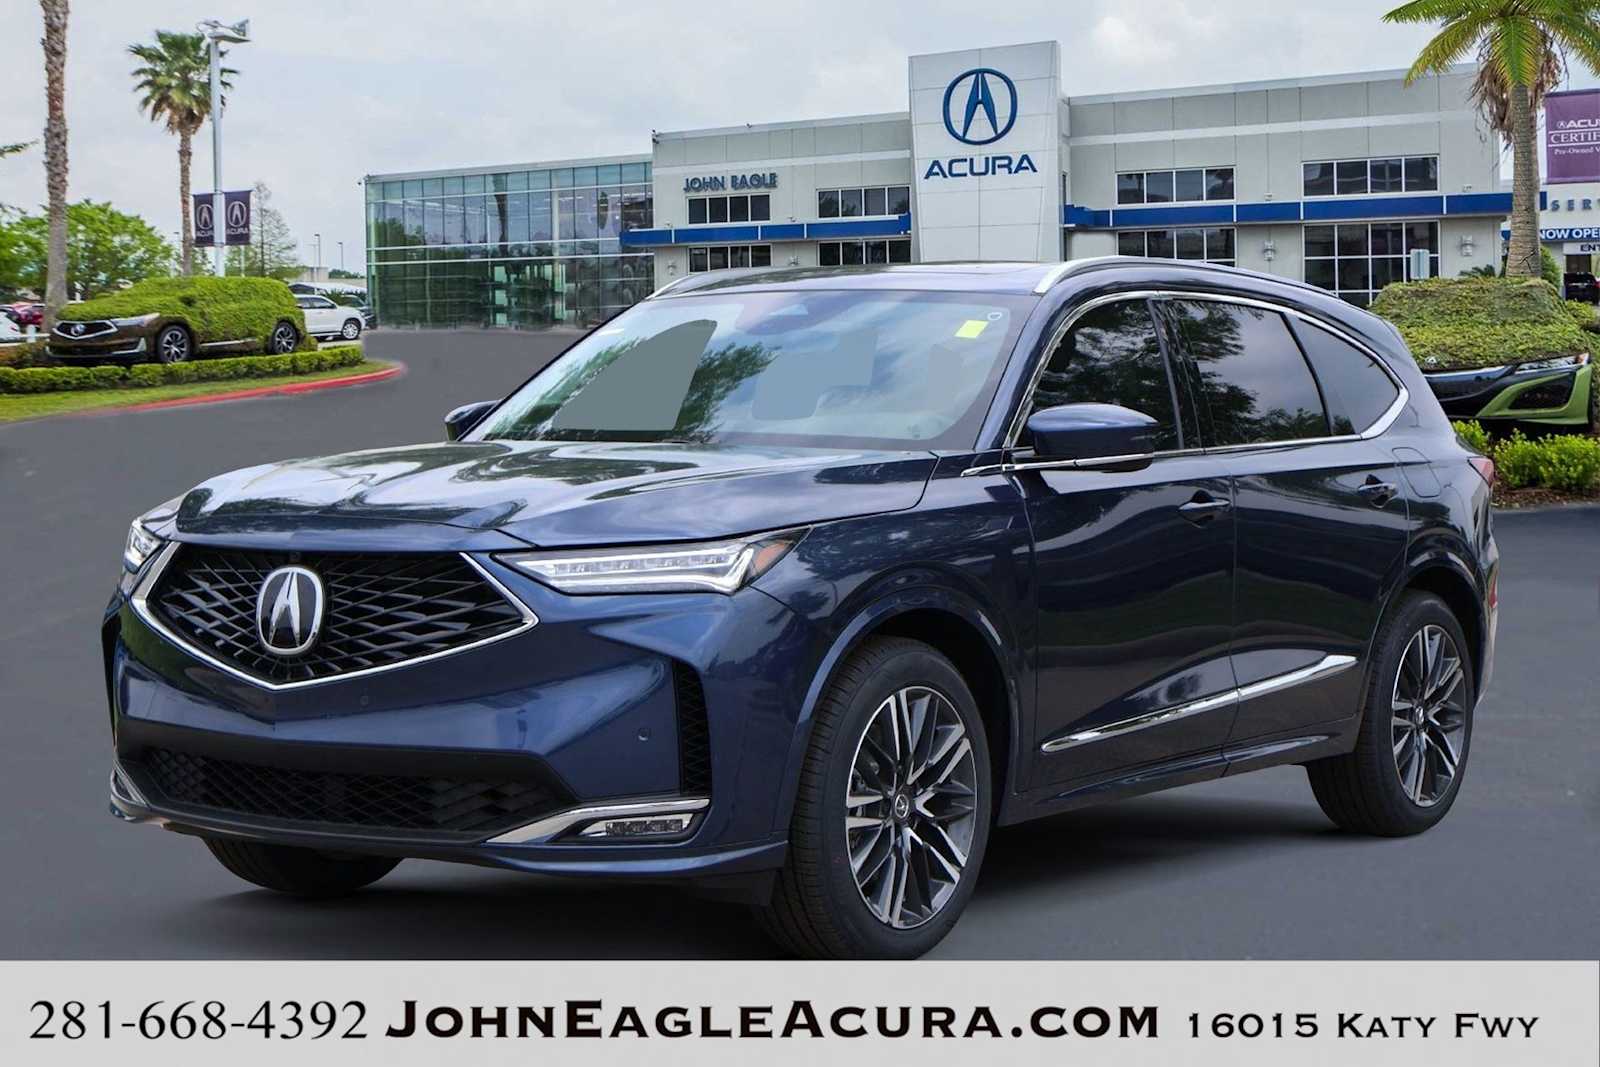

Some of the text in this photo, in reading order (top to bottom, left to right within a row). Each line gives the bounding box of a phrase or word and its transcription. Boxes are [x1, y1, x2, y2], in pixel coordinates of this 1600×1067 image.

[1566, 118, 1600, 129] ACU
[924, 153, 1038, 180] ACURA
[683, 172, 778, 193] JOHN EAGLE
[226, 227, 249, 235] ACURA
[1571, 228, 1600, 239] OPE
